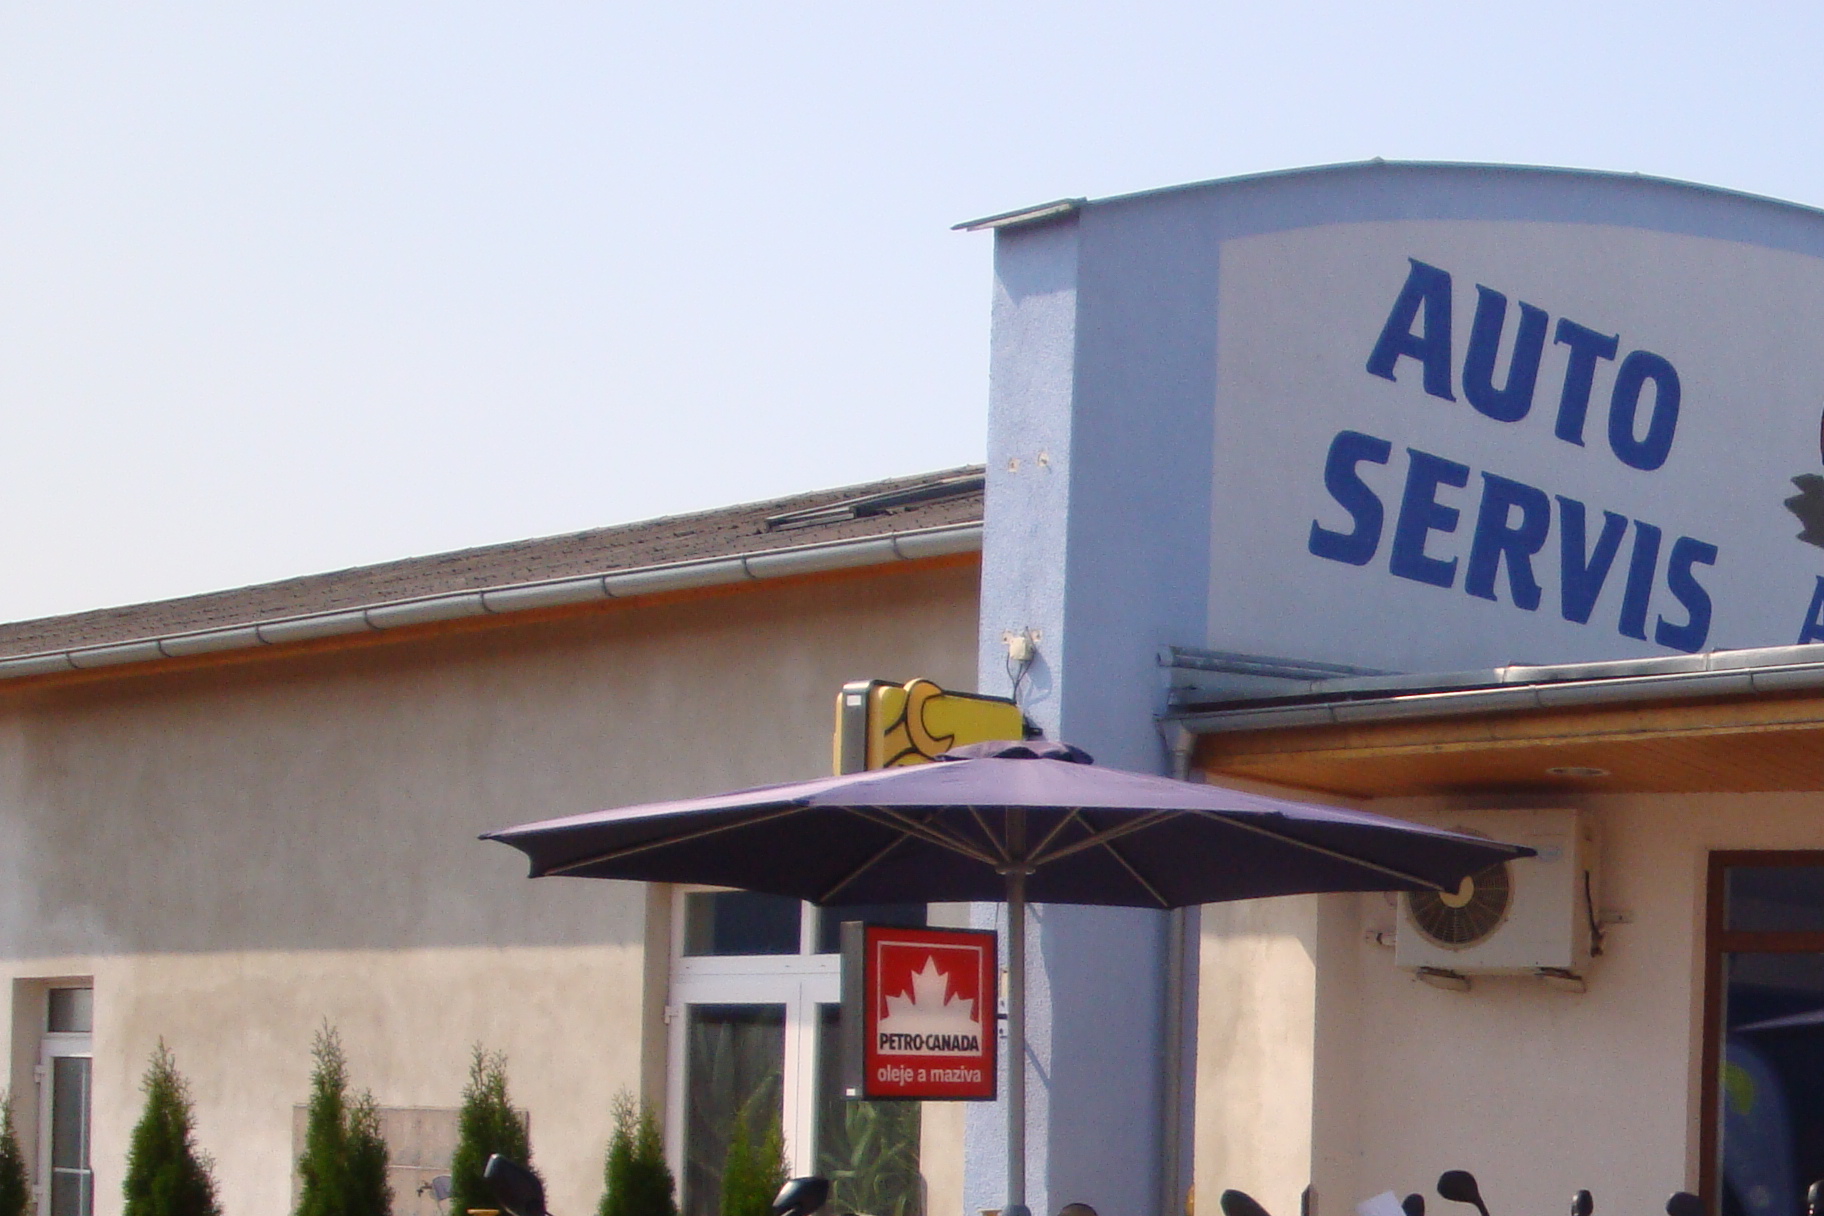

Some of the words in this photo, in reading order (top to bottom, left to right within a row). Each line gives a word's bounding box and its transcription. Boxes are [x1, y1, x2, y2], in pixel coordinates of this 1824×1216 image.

[1367, 257, 1682, 472] AUTO
[1307, 429, 1719, 653] SERVIS
[877, 1064, 914, 1087] oleje
[917, 1068, 926, 1082] a
[930, 1065, 982, 1083] maziva
